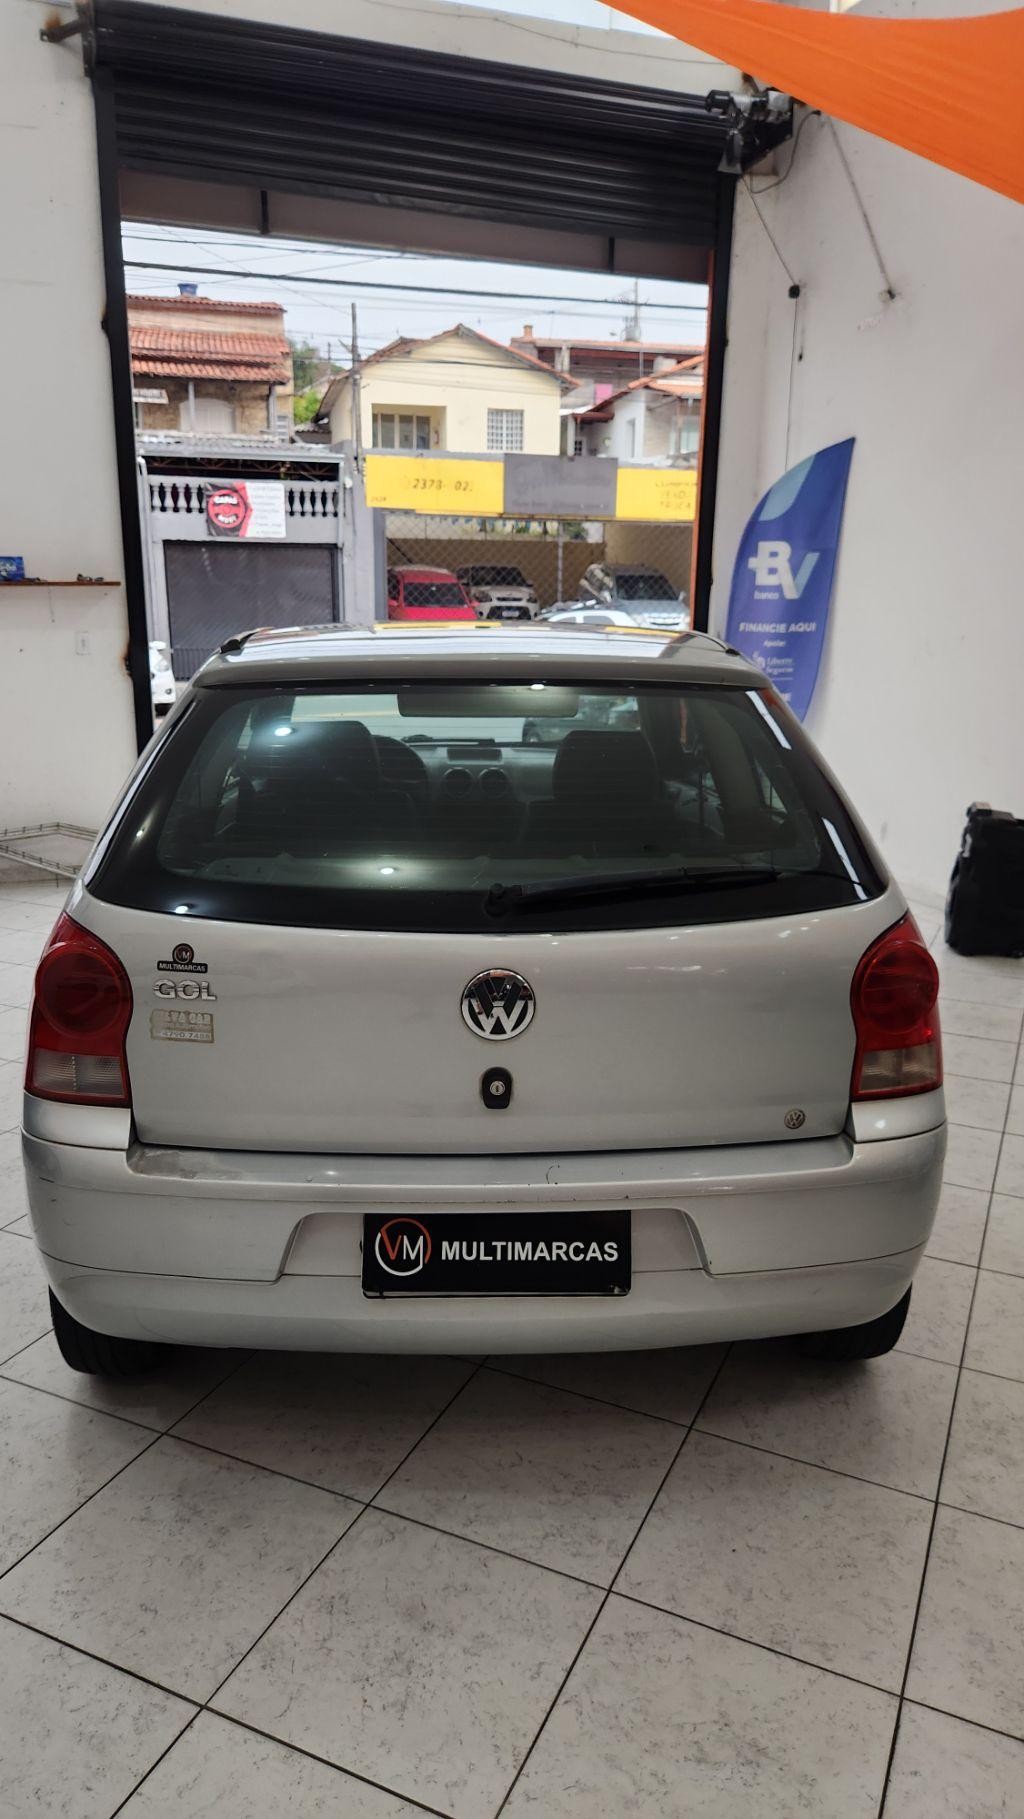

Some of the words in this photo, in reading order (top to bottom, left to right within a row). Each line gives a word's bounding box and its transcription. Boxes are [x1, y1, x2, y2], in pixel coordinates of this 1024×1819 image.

[739, 622, 786, 633] FINANCIE
[788, 622, 816, 633] AQUI
[158, 963, 206, 972] MULTIMARCAS
[153, 979, 216, 1000] GOL
[380, 1228, 425, 1268] VM
[441, 1241, 618, 1262] MULTIMARCAS
